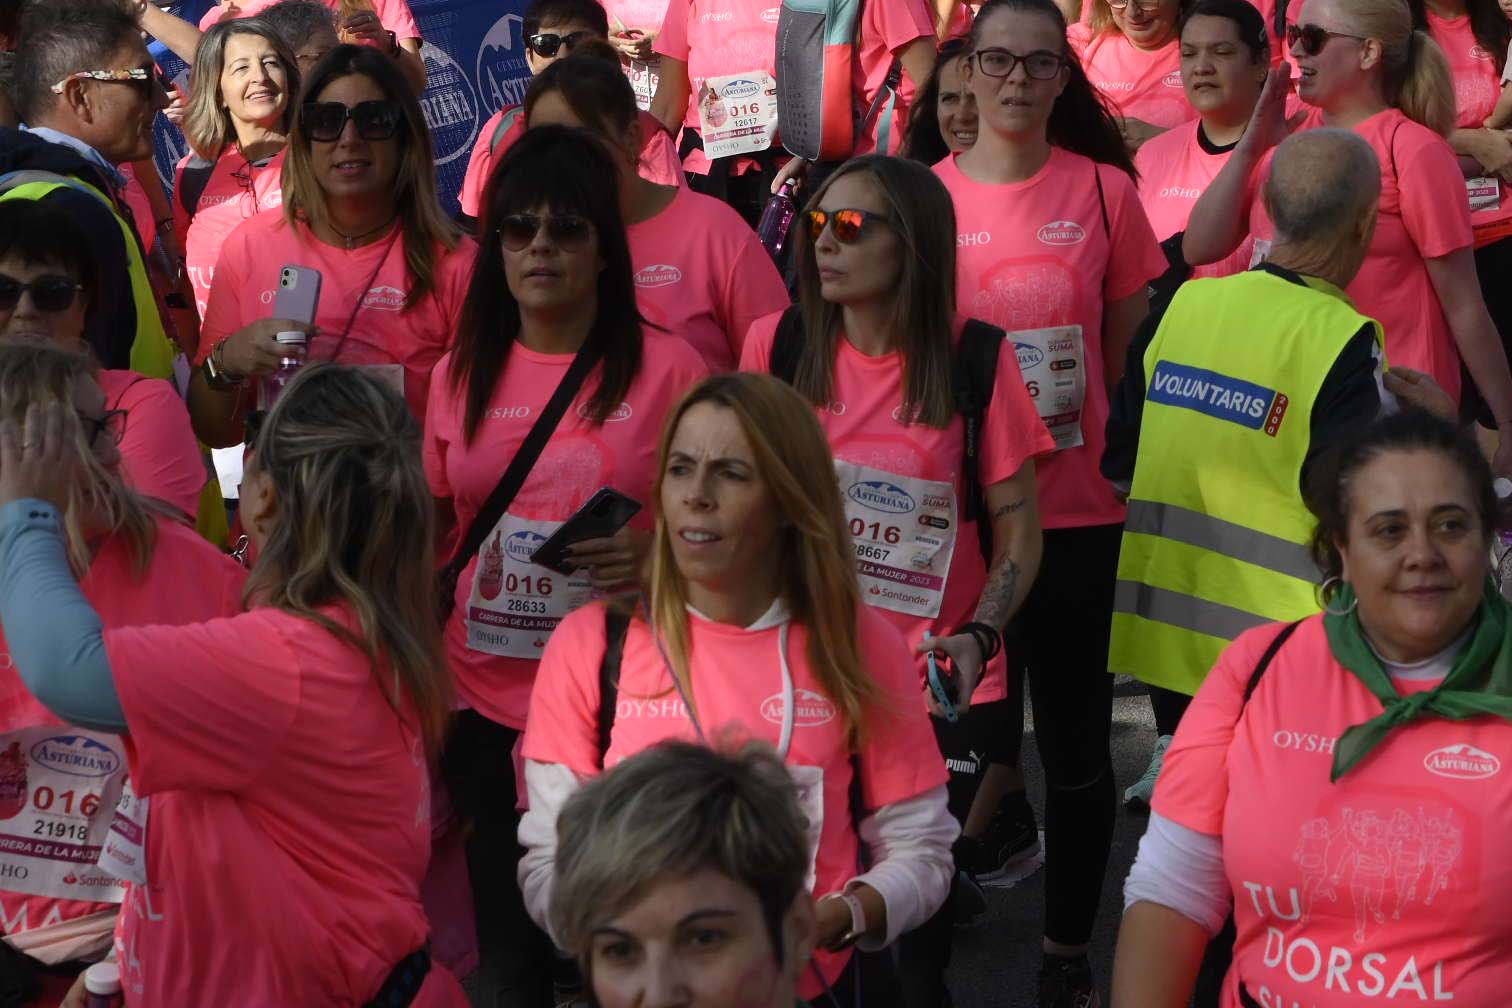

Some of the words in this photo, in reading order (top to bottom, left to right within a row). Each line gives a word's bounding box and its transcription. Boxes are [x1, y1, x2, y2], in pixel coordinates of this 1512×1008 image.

[730, 102, 760, 118] 016
[1040, 228, 1084, 244] ASTURIANA
[635, 272, 679, 284] ASTURIANA
[1153, 370, 1266, 419] VOLUNTARIS
[854, 486, 910, 511] ASTURIANA
[921, 496, 952, 509] SUMA
[850, 517, 901, 545] 016
[505, 573, 553, 596] 016
[863, 564, 875, 573] LA
[876, 566, 908, 582] MUJER
[909, 573, 931, 585] 2023
[507, 599, 547, 614] 28633
[881, 588, 931, 607] Santander
[478, 612, 510, 625] CARRERA
[511, 618, 522, 626] DE
[523, 619, 535, 628] LA
[38, 745, 112, 772] ASTURIANA
[945, 758, 976, 775] PUMA
[1431, 755, 1494, 772] ASTURIANA
[33, 786, 100, 818] 016
[33, 819, 89, 841] 21918
[34, 844, 52, 855] DE
[53, 846, 69, 858] LA
[1243, 880, 1301, 921] TU
[1263, 926, 1454, 1001] DORSAL
